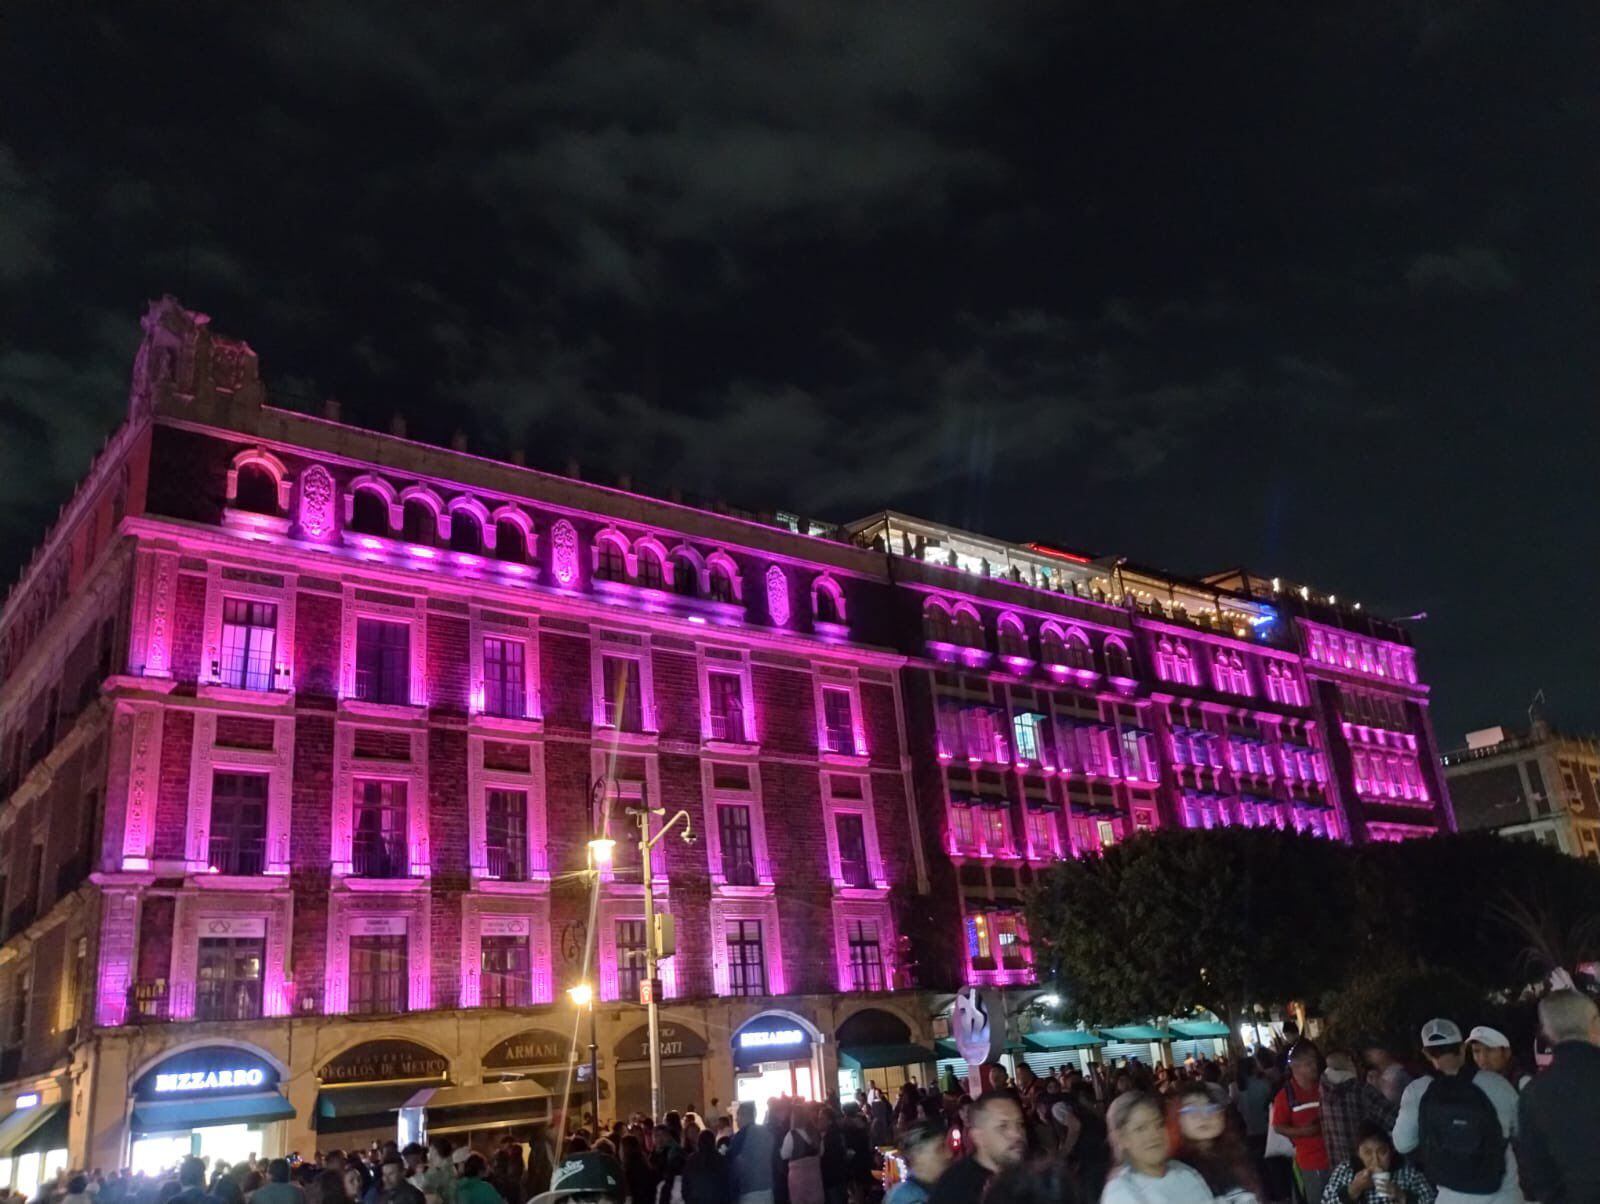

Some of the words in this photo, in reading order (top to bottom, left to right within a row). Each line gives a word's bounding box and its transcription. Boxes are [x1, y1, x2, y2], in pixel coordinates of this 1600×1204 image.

[506, 1044, 558, 1060] ARMANI
[641, 1041, 682, 1056] TRATI
[320, 1063, 376, 1079] REGALOS
[381, 1063, 393, 1075] DE
[155, 1069, 263, 1092] BIZZARRO
